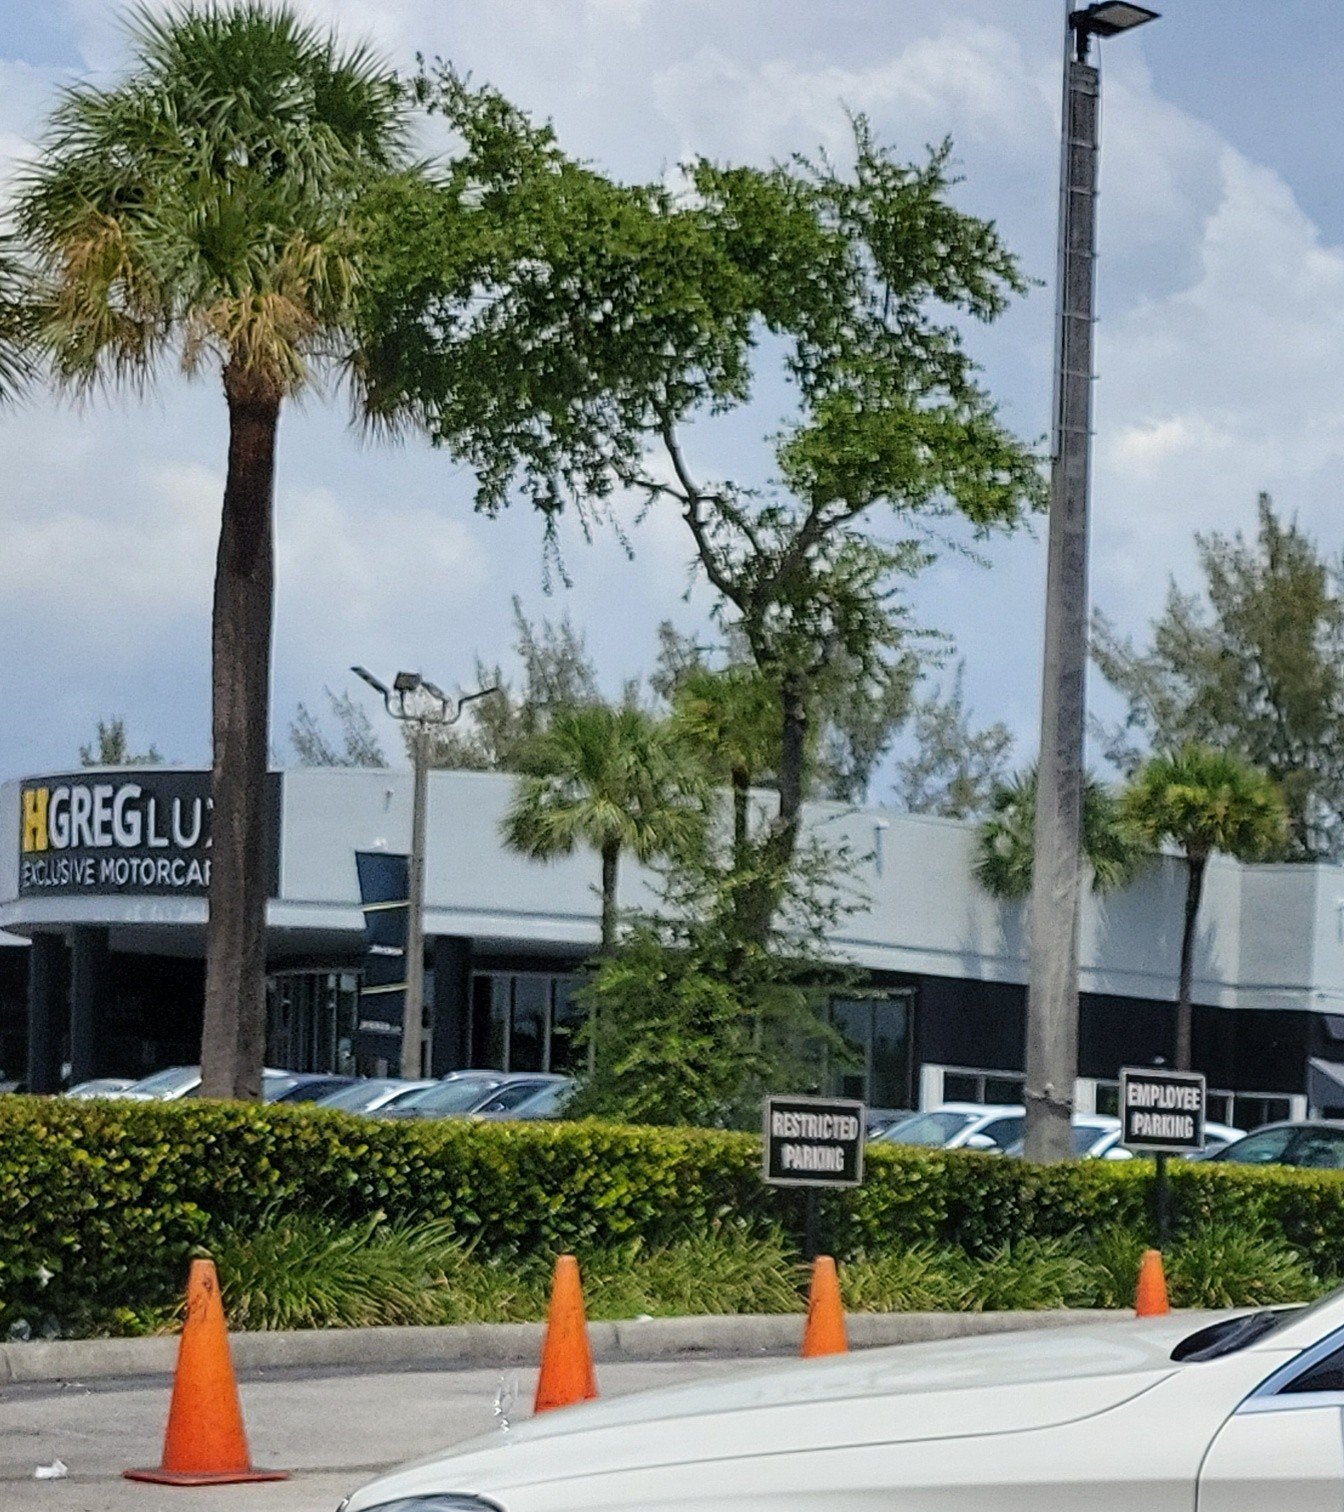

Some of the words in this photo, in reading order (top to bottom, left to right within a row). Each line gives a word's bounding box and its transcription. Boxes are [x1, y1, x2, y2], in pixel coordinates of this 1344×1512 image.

[21, 858, 95, 887] EXCLUSIVE
[1127, 1082, 1200, 1110] EMPLOYEE
[772, 1110, 858, 1140] RESTRICTED
[1131, 1111, 1194, 1138] PARKING
[782, 1143, 844, 1171] PARKING
